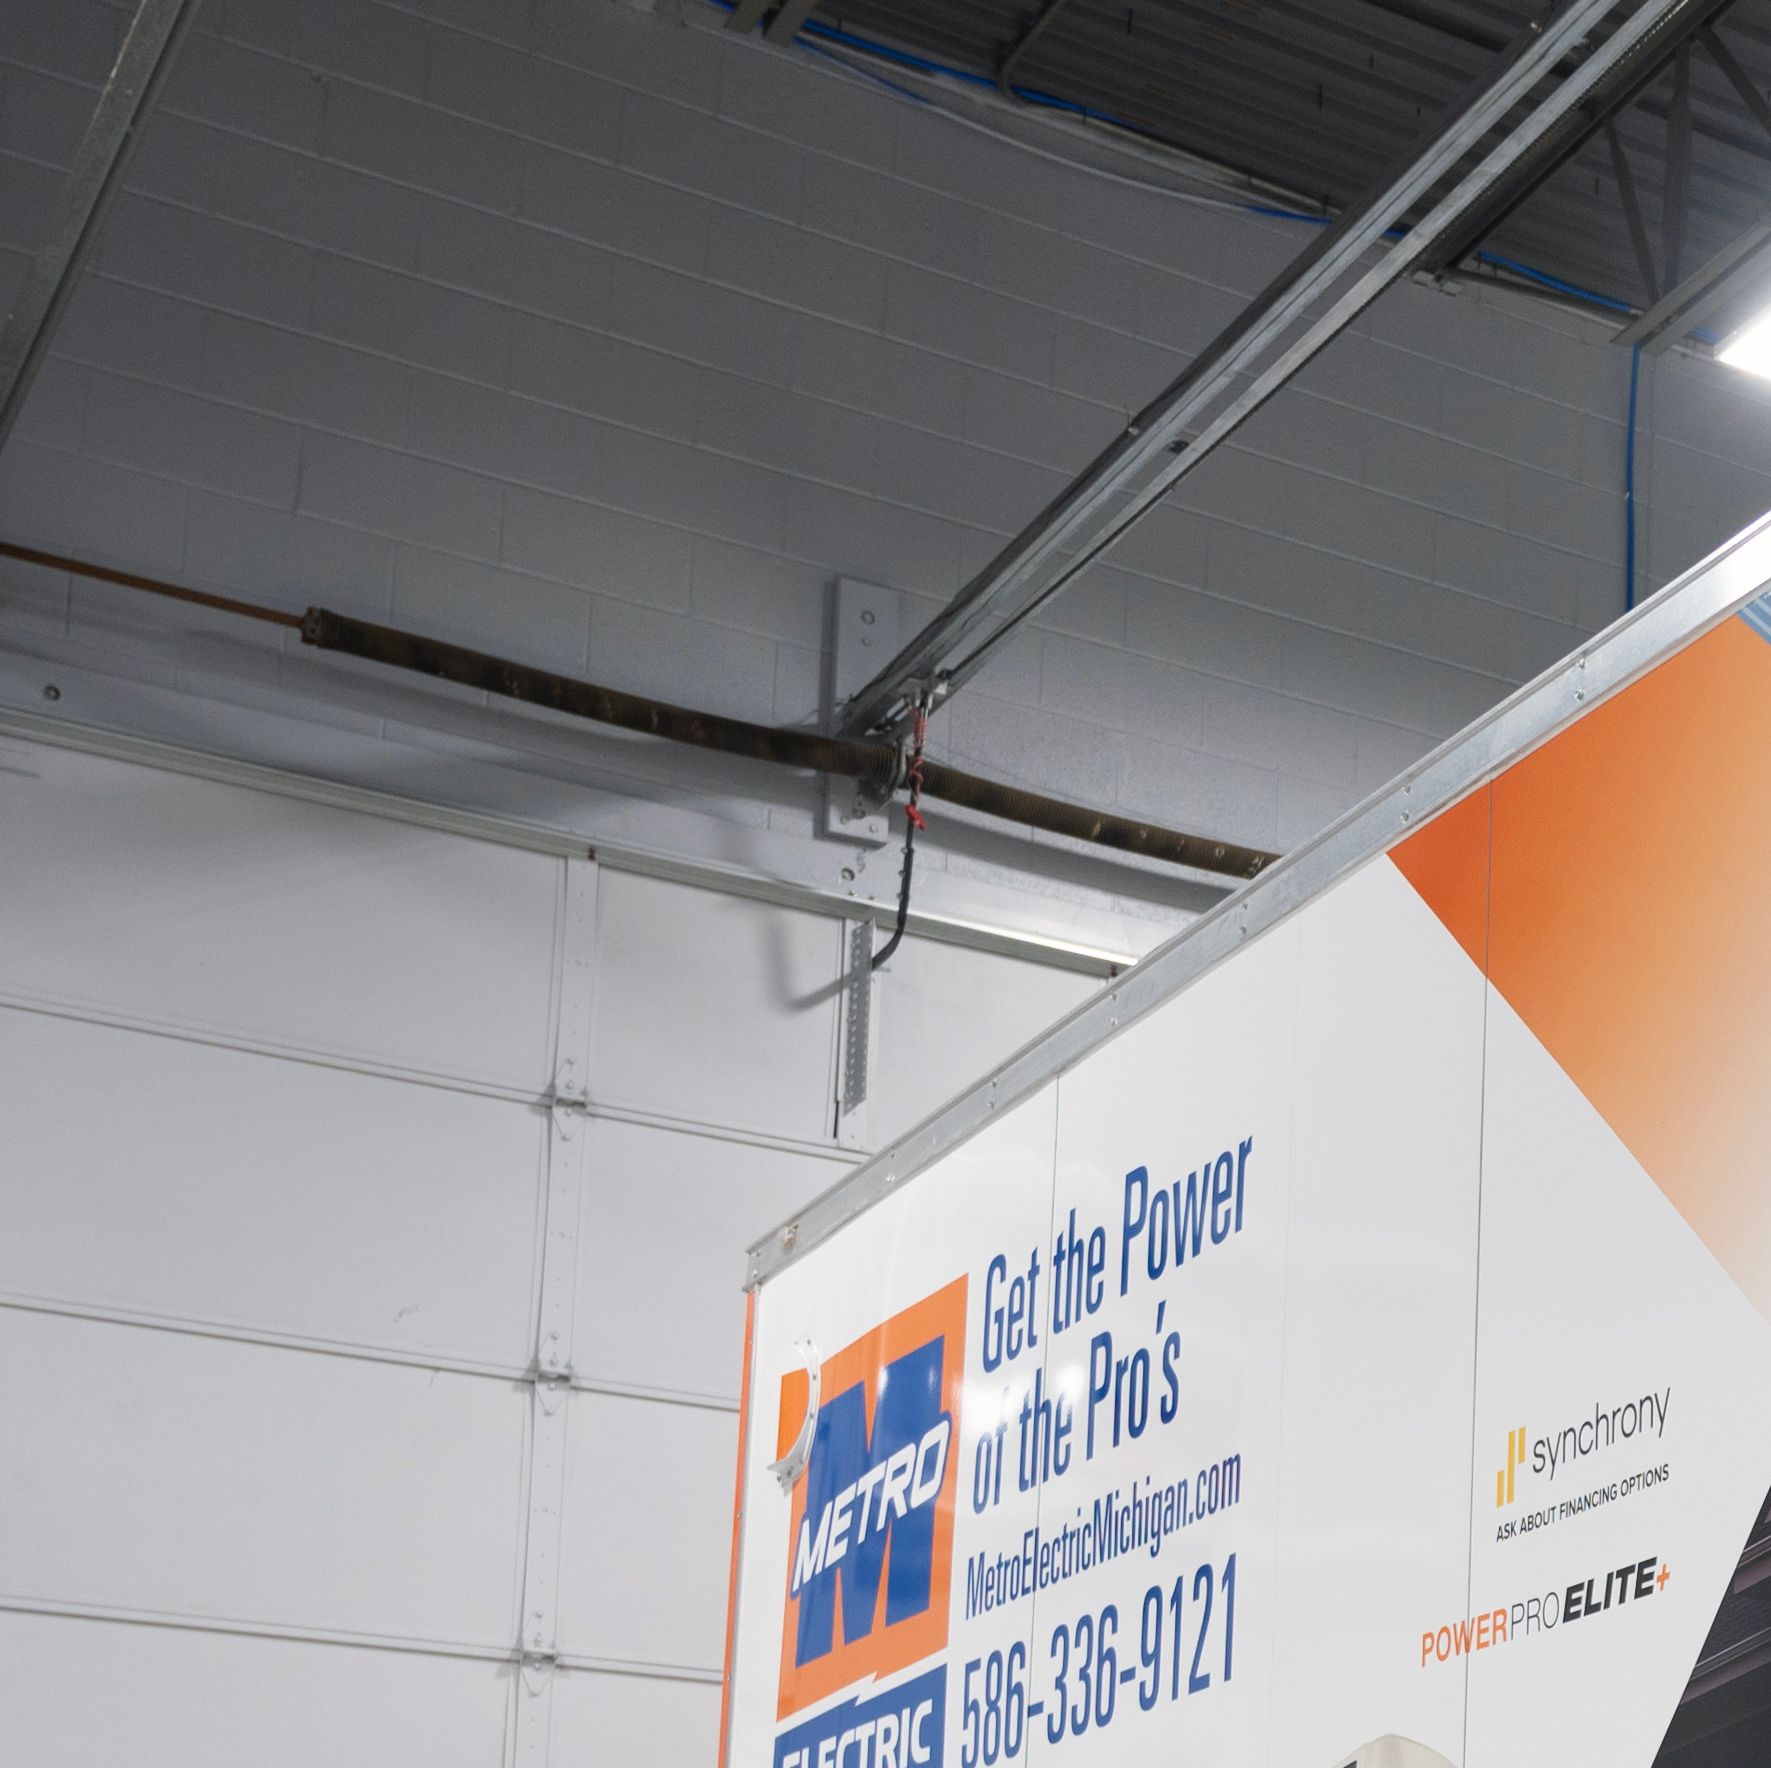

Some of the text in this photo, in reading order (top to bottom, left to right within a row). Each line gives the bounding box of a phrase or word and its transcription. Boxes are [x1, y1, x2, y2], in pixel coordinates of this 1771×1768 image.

[982, 1134, 1254, 1374] Get the Power
[972, 1300, 1183, 1515] of the Pro's
[1532, 1386, 1671, 1481] synchrony
[788, 1418, 950, 1596] METRO
[964, 1452, 1242, 1621] MetroElectricMichigan.com
[1496, 1463, 1670, 1543] ASK ABOUT FINANCING OPTIONS
